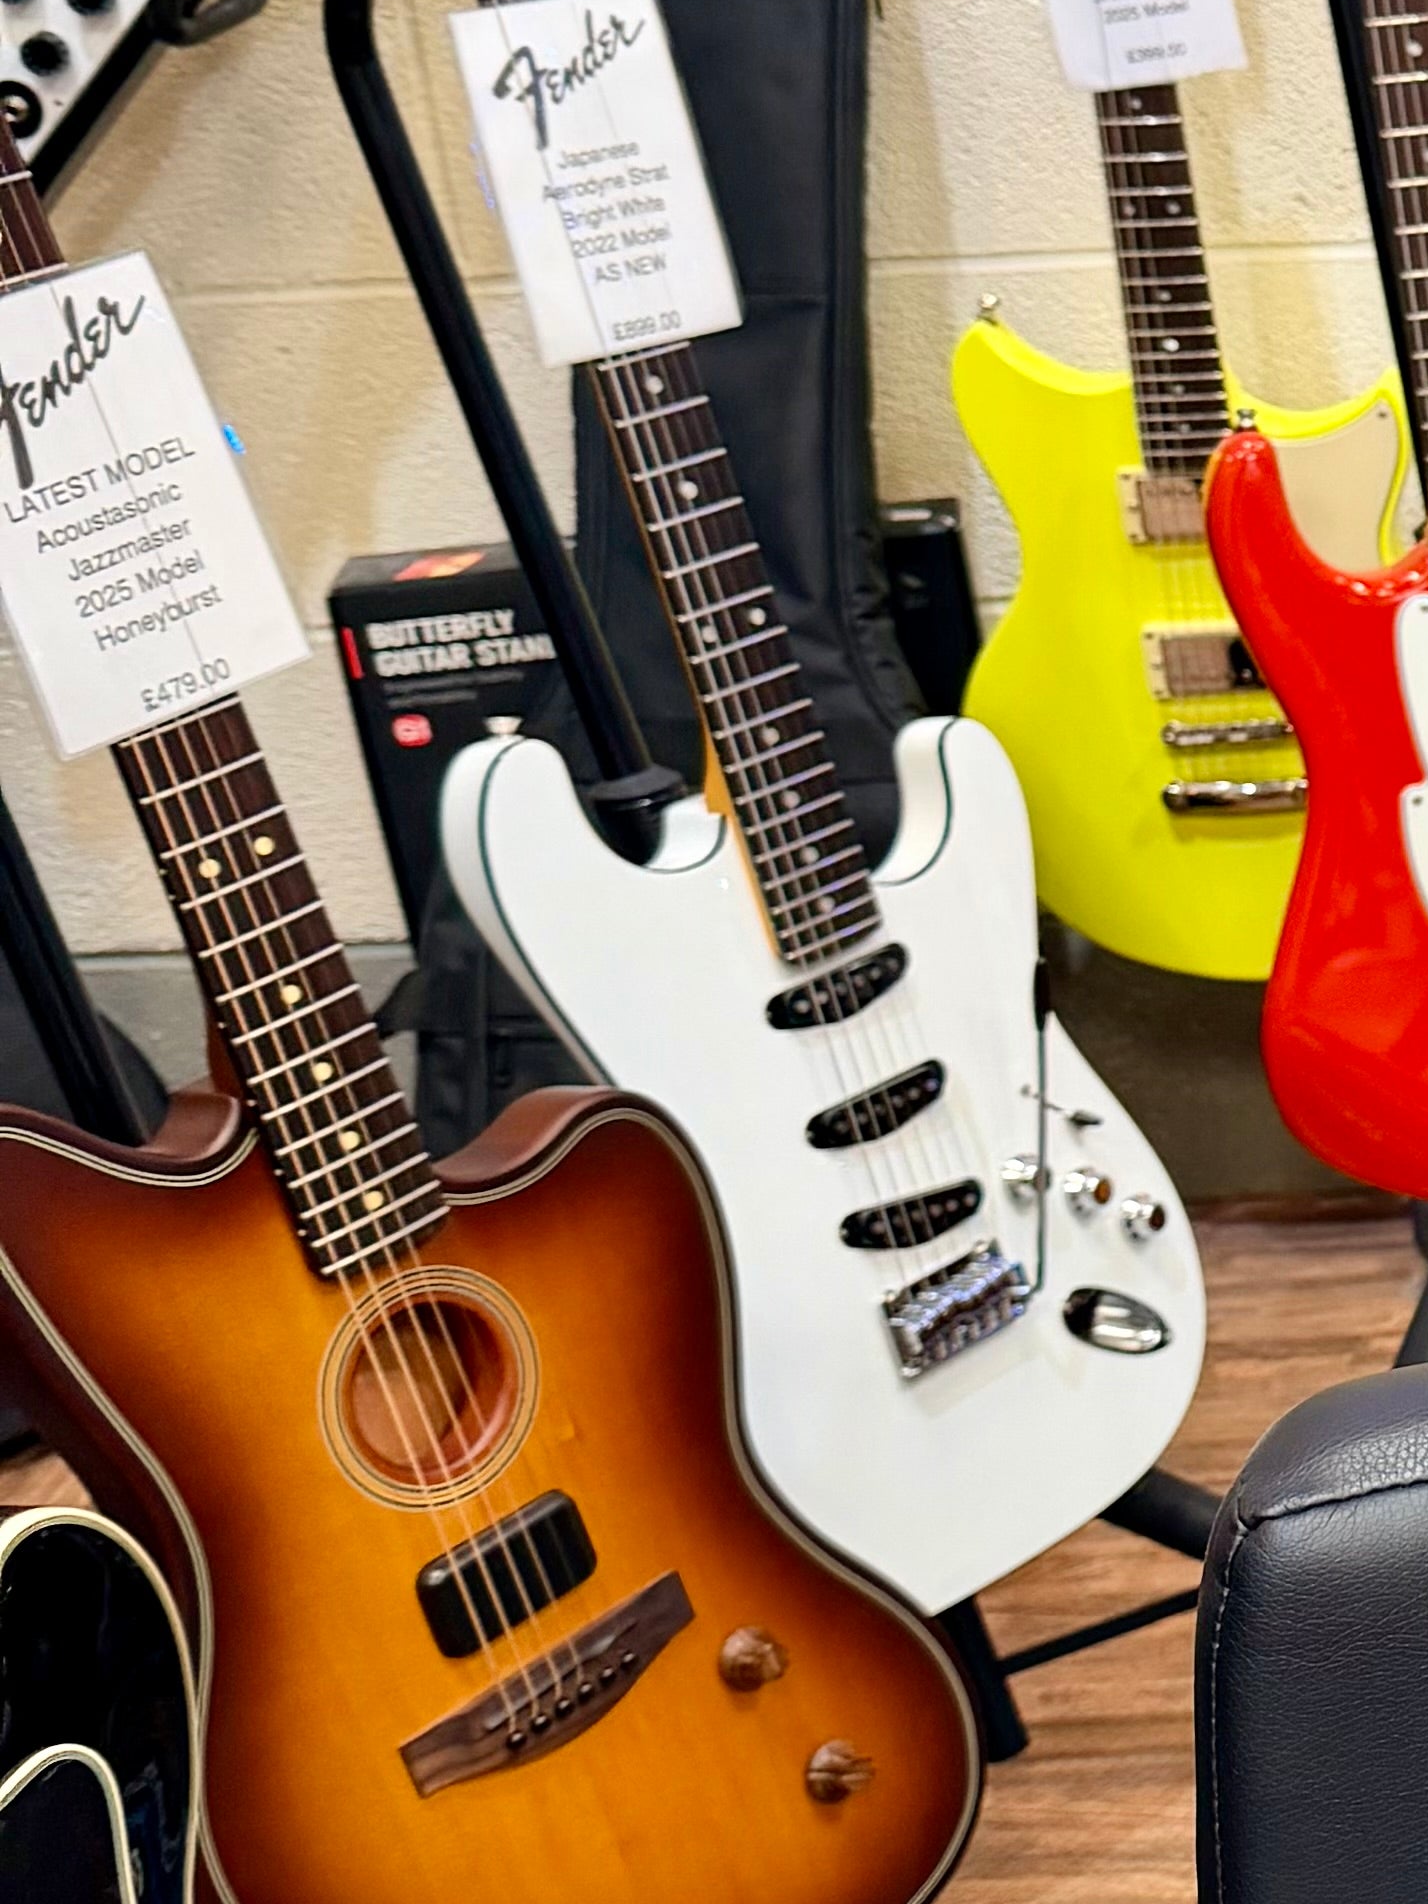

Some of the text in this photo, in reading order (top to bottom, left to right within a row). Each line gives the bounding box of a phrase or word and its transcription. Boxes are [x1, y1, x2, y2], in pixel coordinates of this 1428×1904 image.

[492, 9, 645, 150] Fender
[621, 222, 672, 248] Model
[626, 254, 667, 277] NEW
[2, 436, 197, 524] LATEST MODEL
[37, 481, 183, 554] Acoustasonic
[67, 515, 193, 582] Jazzmaster
[75, 549, 206, 619] 2025 Model
[94, 584, 223, 652] Honeyburst
[366, 608, 514, 650] BUTTERFLY
[140, 658, 232, 712] £479.00
[373, 642, 473, 677] GUITAR
